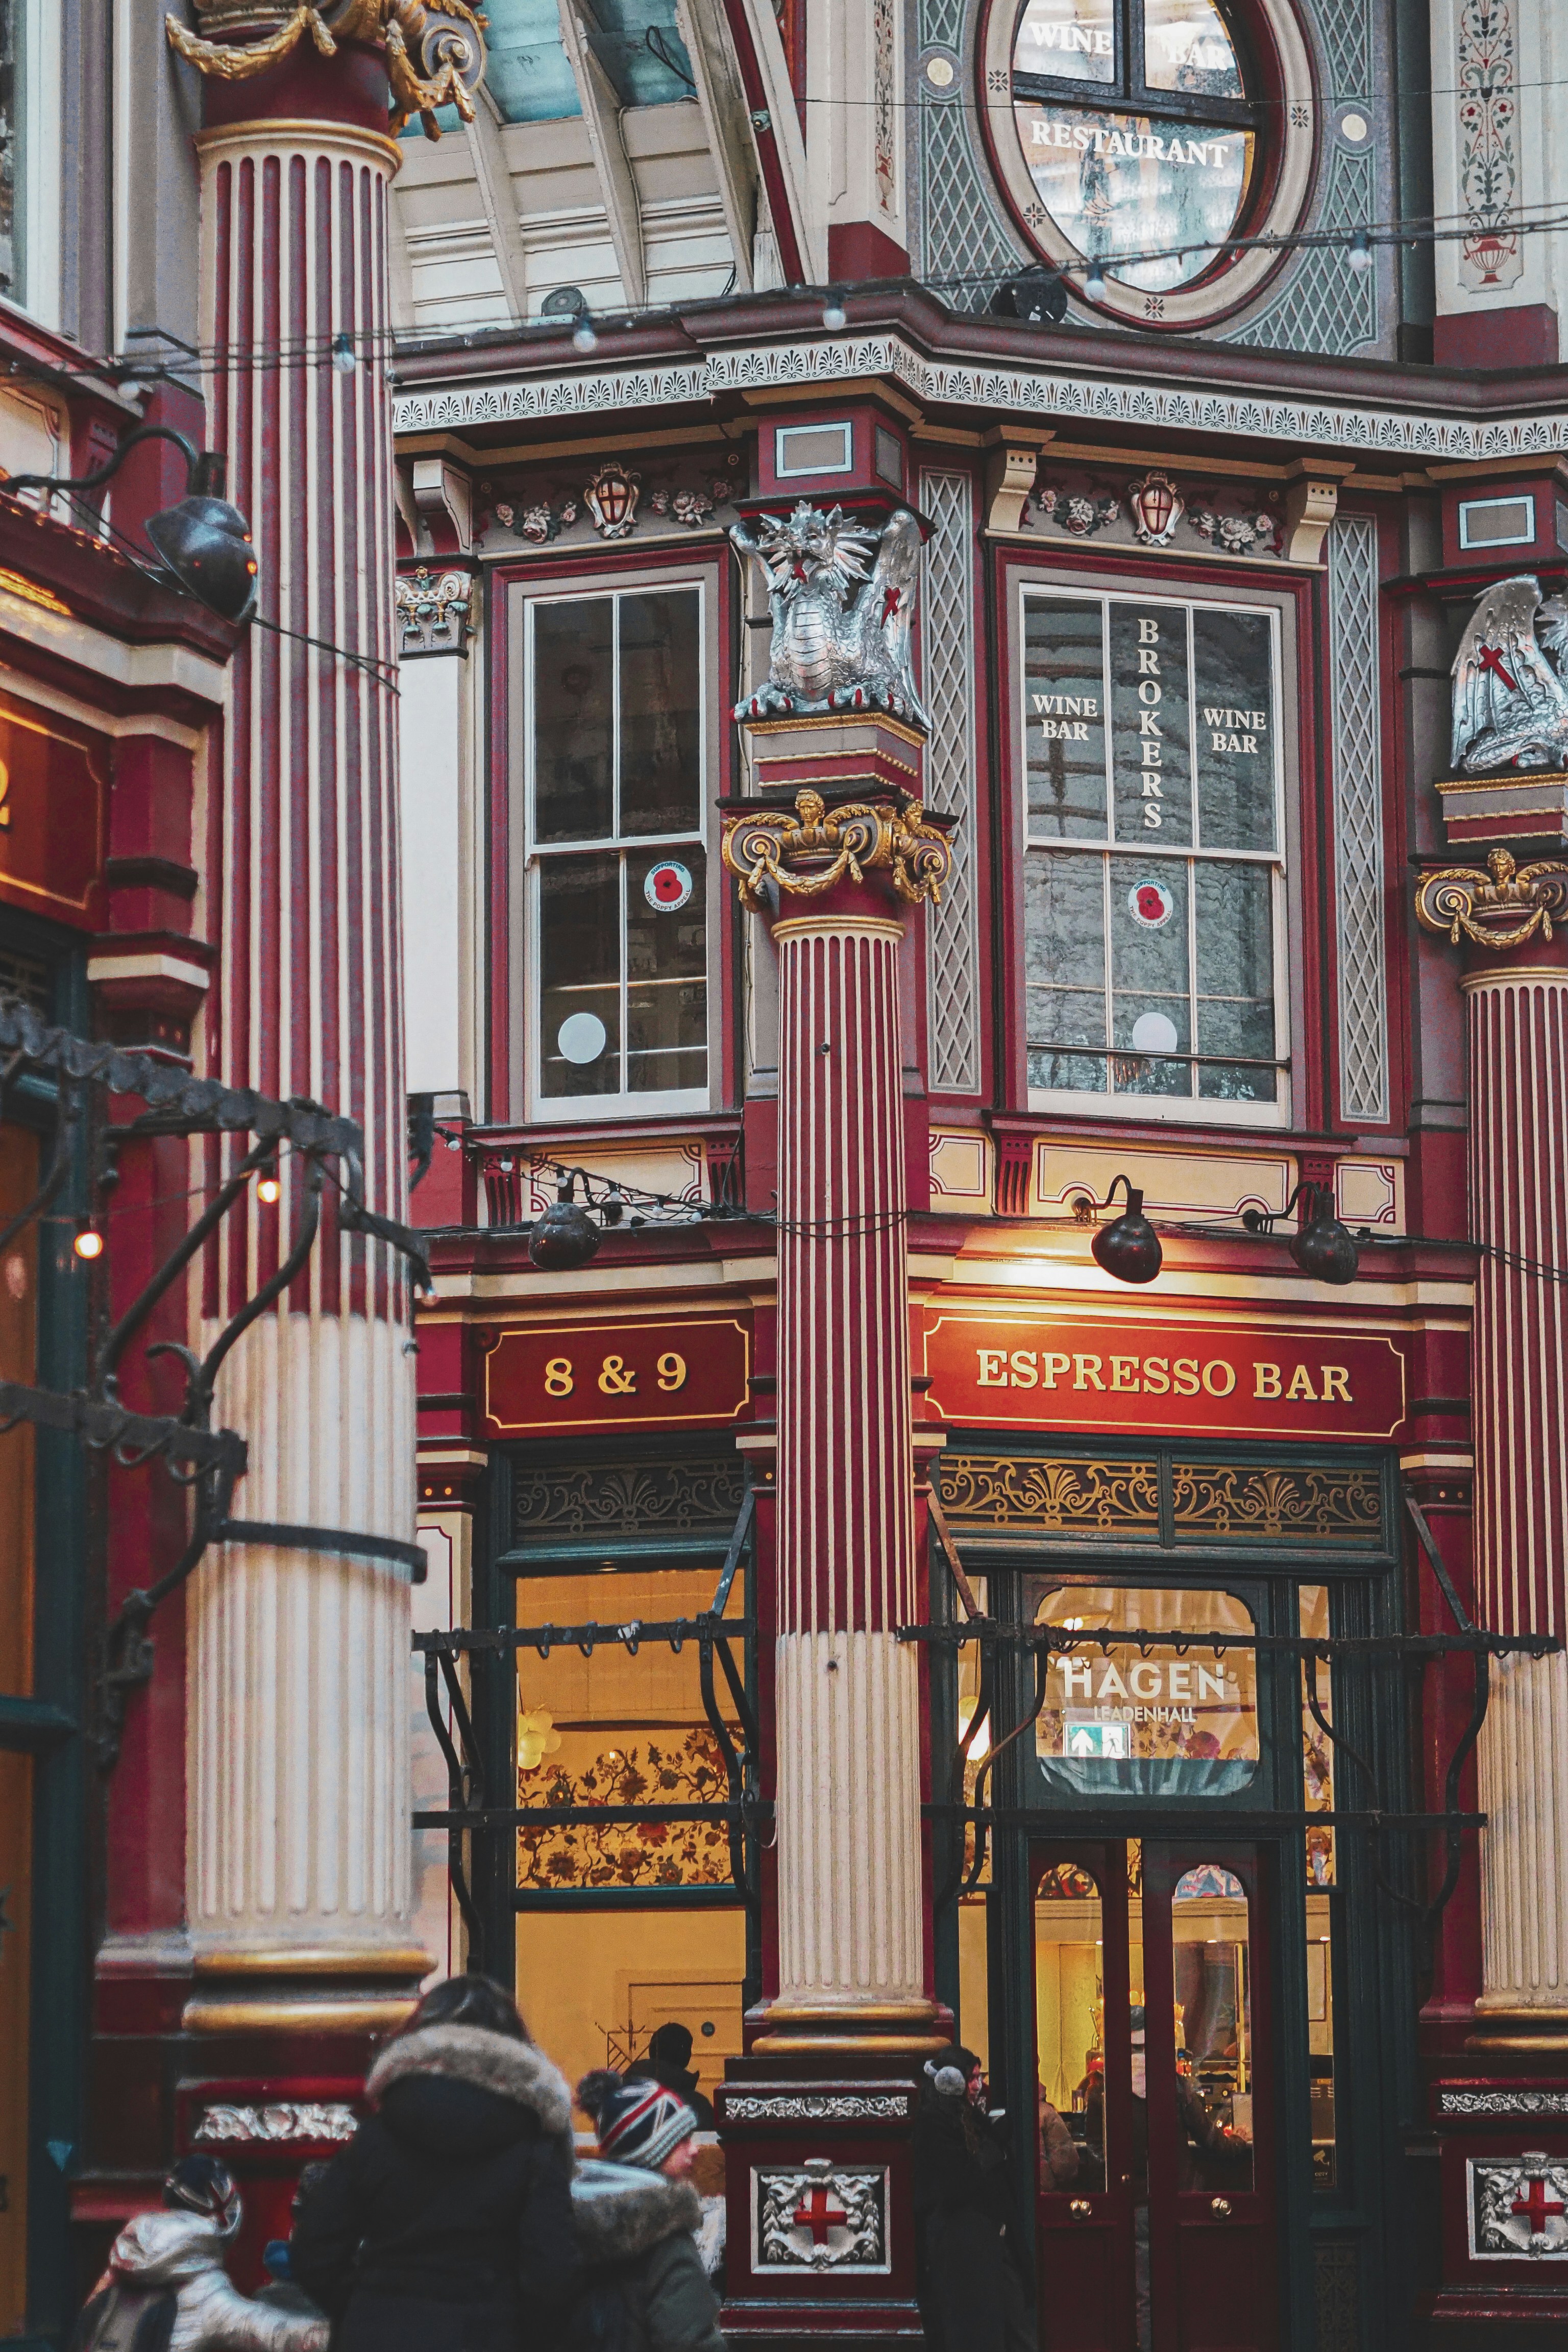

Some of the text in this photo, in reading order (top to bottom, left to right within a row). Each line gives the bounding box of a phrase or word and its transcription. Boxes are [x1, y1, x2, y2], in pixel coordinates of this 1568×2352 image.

[1030, 22, 1228, 71] WINE BAR
[1031, 120, 1229, 168] RESTAURANT
[1032, 694, 1098, 718] WINE
[1041, 720, 1089, 741] BAR
[1138, 619, 1163, 828] BROKERS
[1204, 708, 1267, 731] WINE
[1212, 733, 1259, 754] BAR
[651, 862, 685, 875] SUPPORTING
[1134, 880, 1166, 892] SUPPORTING
[652, 902, 672, 911] POPPY
[674, 889, 691, 909] APPEAL
[1136, 918, 1155, 927] POPPY
[544, 1352, 687, 1396] 8 & 9
[976, 1349, 1354, 1402] ESPRESSO BAR
[1064, 1661, 1224, 1700] HAGEN
[1094, 1706, 1197, 1723] LEADENHALL
